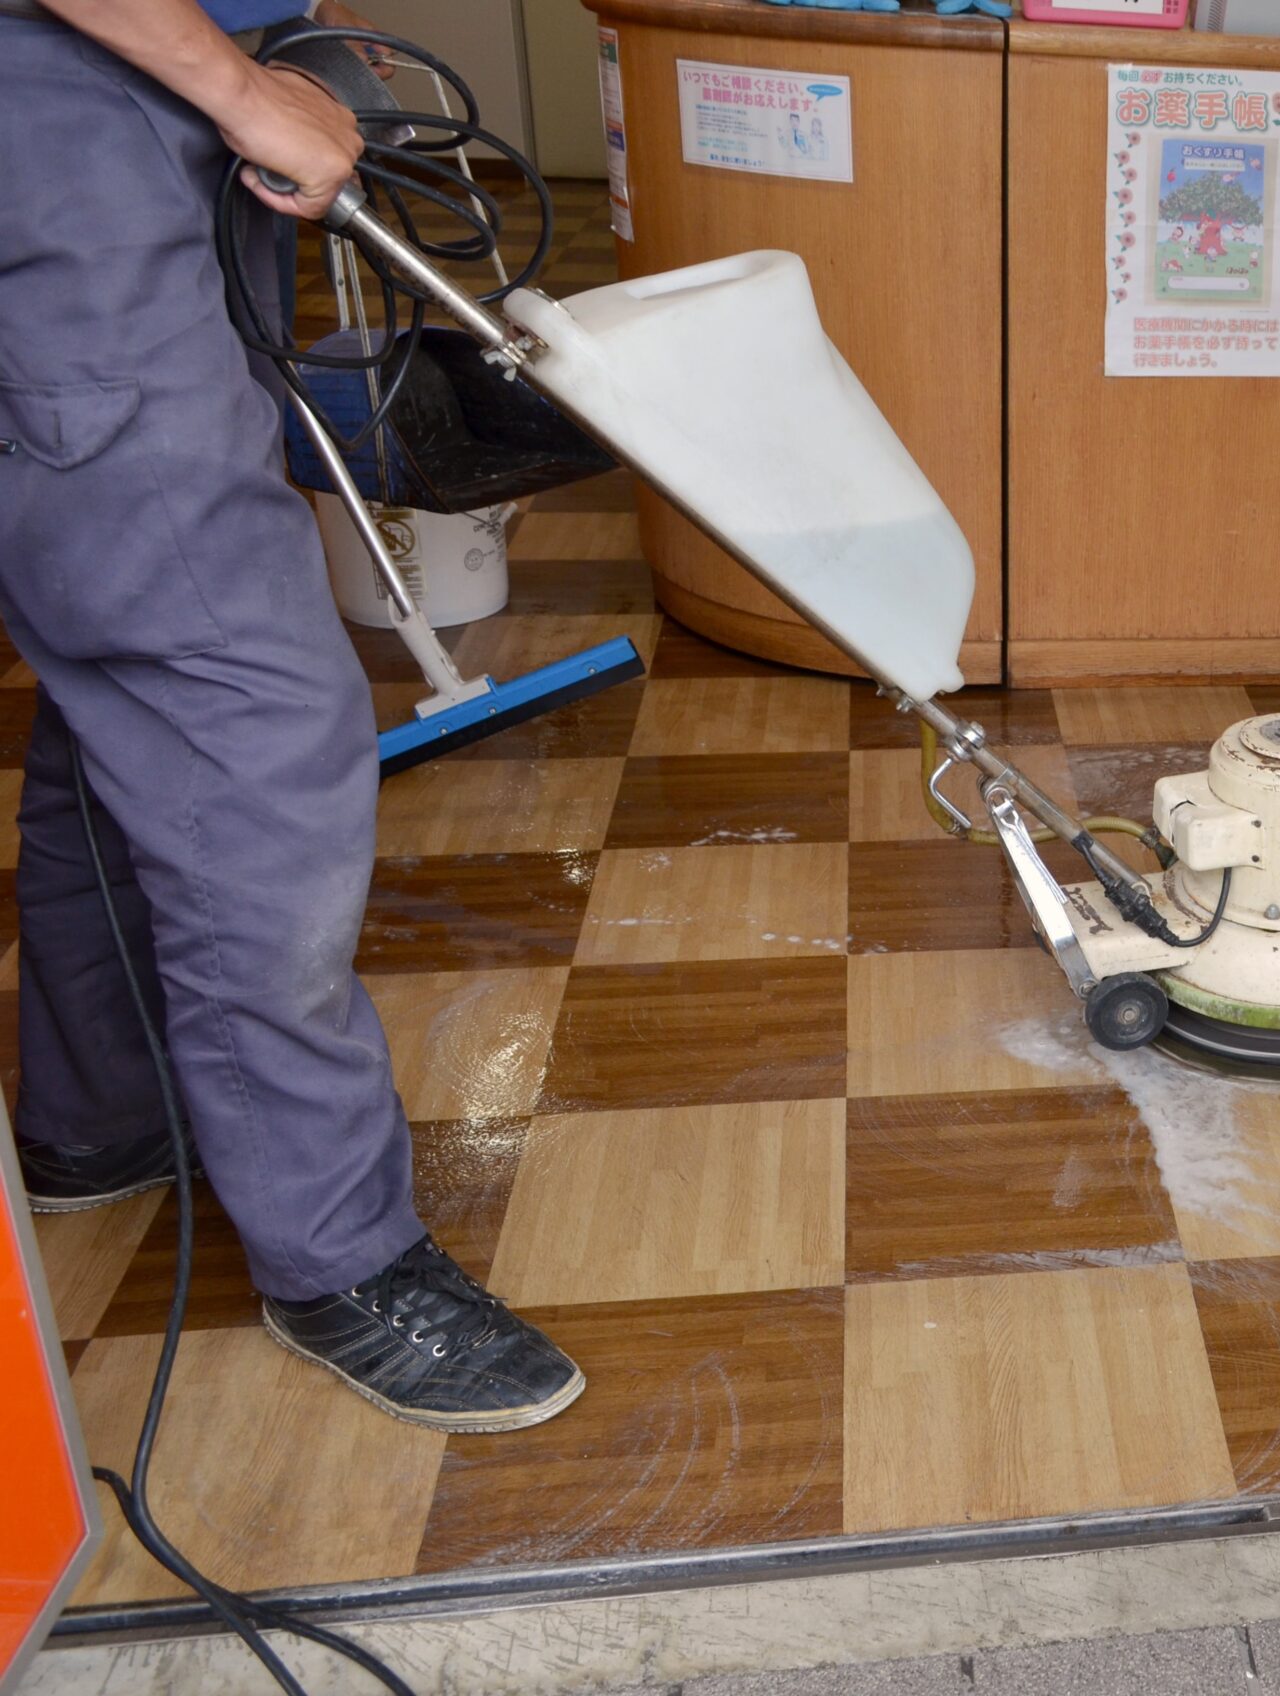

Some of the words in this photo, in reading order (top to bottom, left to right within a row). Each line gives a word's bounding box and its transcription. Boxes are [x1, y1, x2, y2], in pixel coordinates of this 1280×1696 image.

[1116, 87, 1268, 131] お薬手帳
[1133, 353, 1218, 368] 行きましょう。
